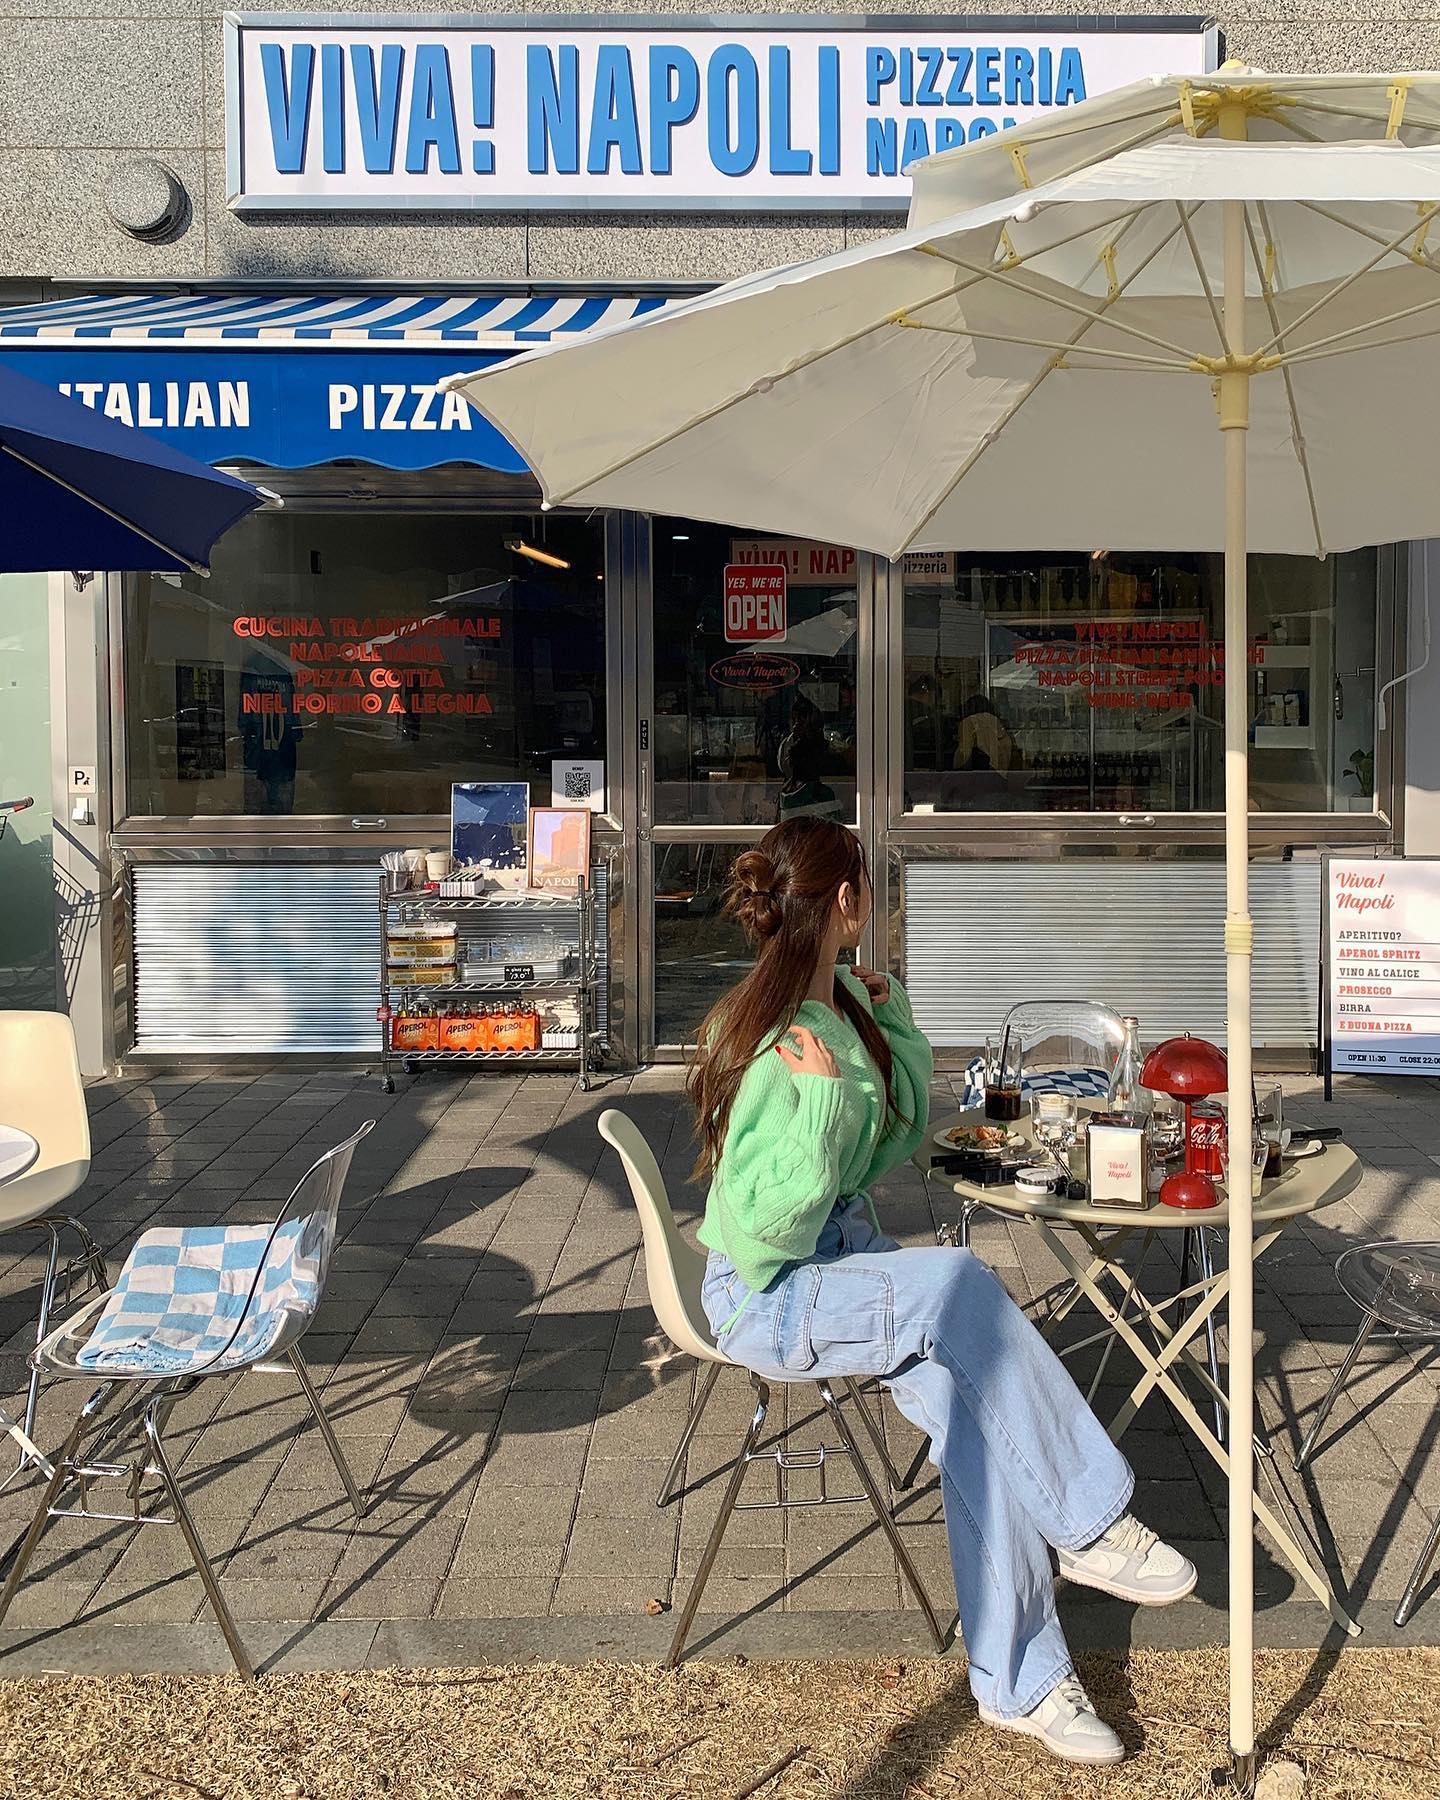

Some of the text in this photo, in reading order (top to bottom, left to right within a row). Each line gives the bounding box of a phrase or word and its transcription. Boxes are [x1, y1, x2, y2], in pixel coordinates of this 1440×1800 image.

[866, 47, 1087, 106] PIZZERIA
[260, 43, 841, 177] VIVA! NAPOLI
[58, 381, 250, 428] TALIAN
[328, 384, 473, 430] PIZZA
[727, 577, 783, 590] YES, WE'RE
[728, 595, 783, 631] OPEN
[233, 616, 502, 638] CUCINA TRADIZIONALE
[1132, 623, 1206, 639] NAPOLI
[290, 642, 445, 662] NAPOLETANA
[297, 667, 445, 688] PIZZA COTTA
[753, 665, 788, 679] Napoli
[1039, 671, 1225, 686] NAPOLI STREET FOO
[242, 693, 493, 715] NEL FORNO A LEGNA
[533, 877, 578, 887] NAPOL
[1336, 872, 1385, 889] Viva!
[1336, 893, 1395, 915] Napoli
[1338, 930, 1402, 941] APERITIVO?
[1339, 948, 1421, 960] APEROL SPRITZ
[1339, 967, 1420, 979] VINO AL CALICE
[1339, 985, 1393, 996] PROSECCO
[1339, 1003, 1372, 1013] BIRRA
[398, 1021, 428, 1034] APEROL
[446, 1022, 476, 1035] APEROL
[493, 1021, 524, 1034] APEROL
[1339, 1020, 1412, 1032] E BUONA PIZZA
[1348, 1054, 1367, 1062] OPEN
[1399, 1056, 1421, 1064] CLOSE
[1108, 1170, 1133, 1180] Napoli
